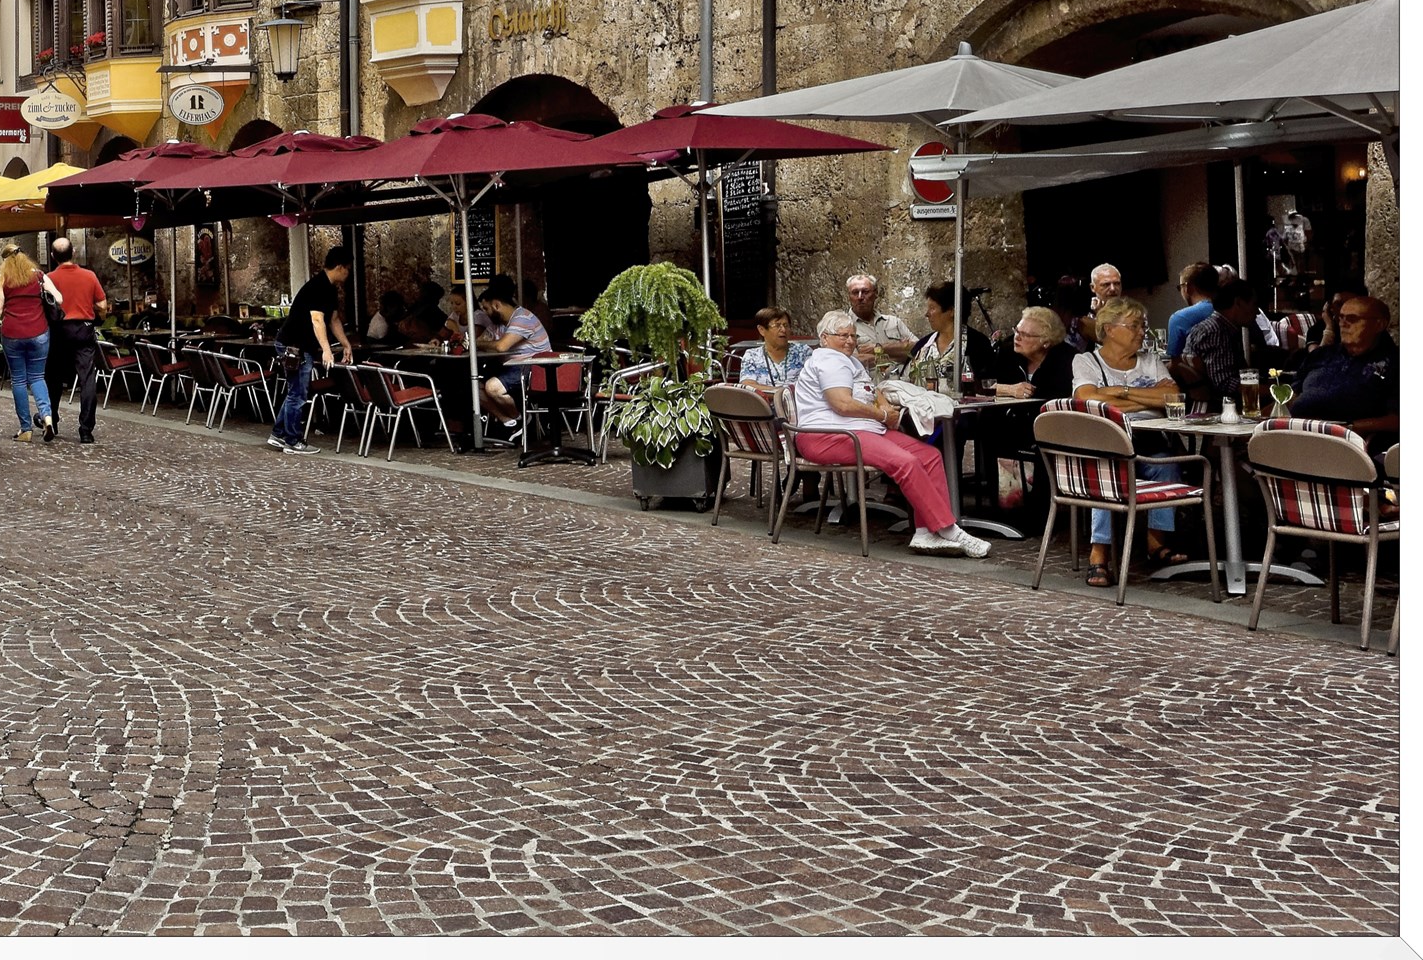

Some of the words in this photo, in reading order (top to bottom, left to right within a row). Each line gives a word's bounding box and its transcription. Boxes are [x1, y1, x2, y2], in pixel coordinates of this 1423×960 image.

[28, 102, 42, 113] zimt
[43, 101, 54, 113] &
[55, 101, 76, 113] zucker
[178, 109, 217, 122] ELFERHAUS
[916, 207, 950, 215] ausgenommen
